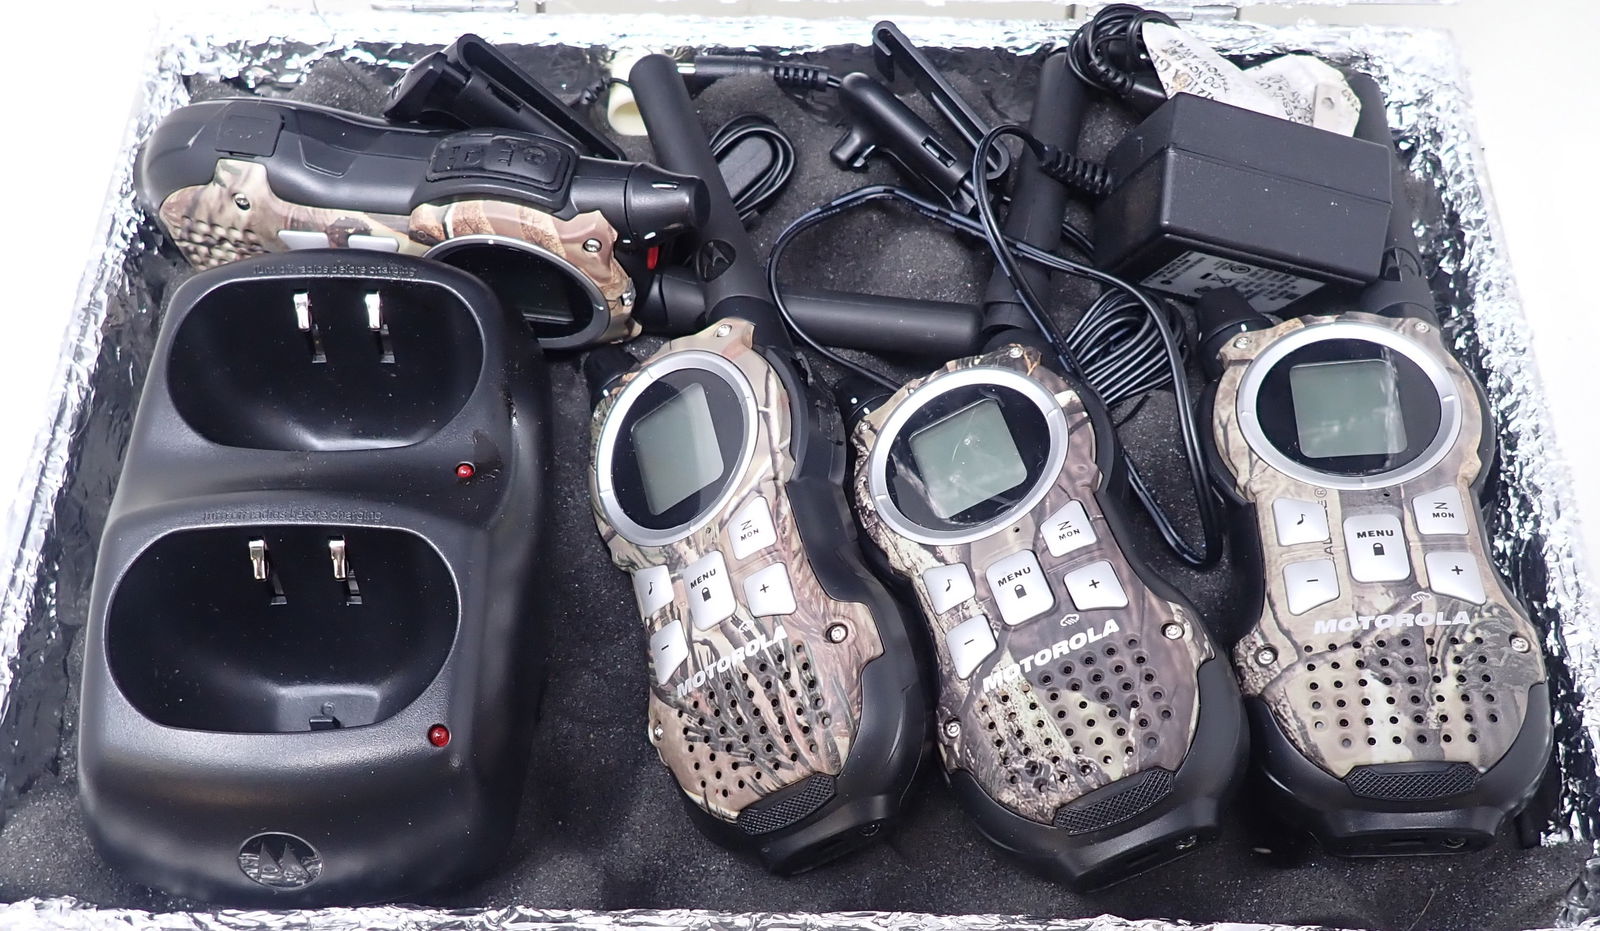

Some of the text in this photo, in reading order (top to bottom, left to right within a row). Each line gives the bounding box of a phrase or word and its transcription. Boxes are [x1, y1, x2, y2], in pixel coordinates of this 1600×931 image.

[1431, 511, 1456, 519] MON
[740, 528, 760, 542] MON
[1058, 528, 1081, 541] MON
[1356, 529, 1395, 539] MENU
[689, 568, 717, 589] MENU
[997, 566, 1032, 587] MENU
[1313, 611, 1472, 635] MOTOROLA
[676, 625, 788, 698] MOTOROLA
[982, 618, 1121, 694] MOTOROLA
